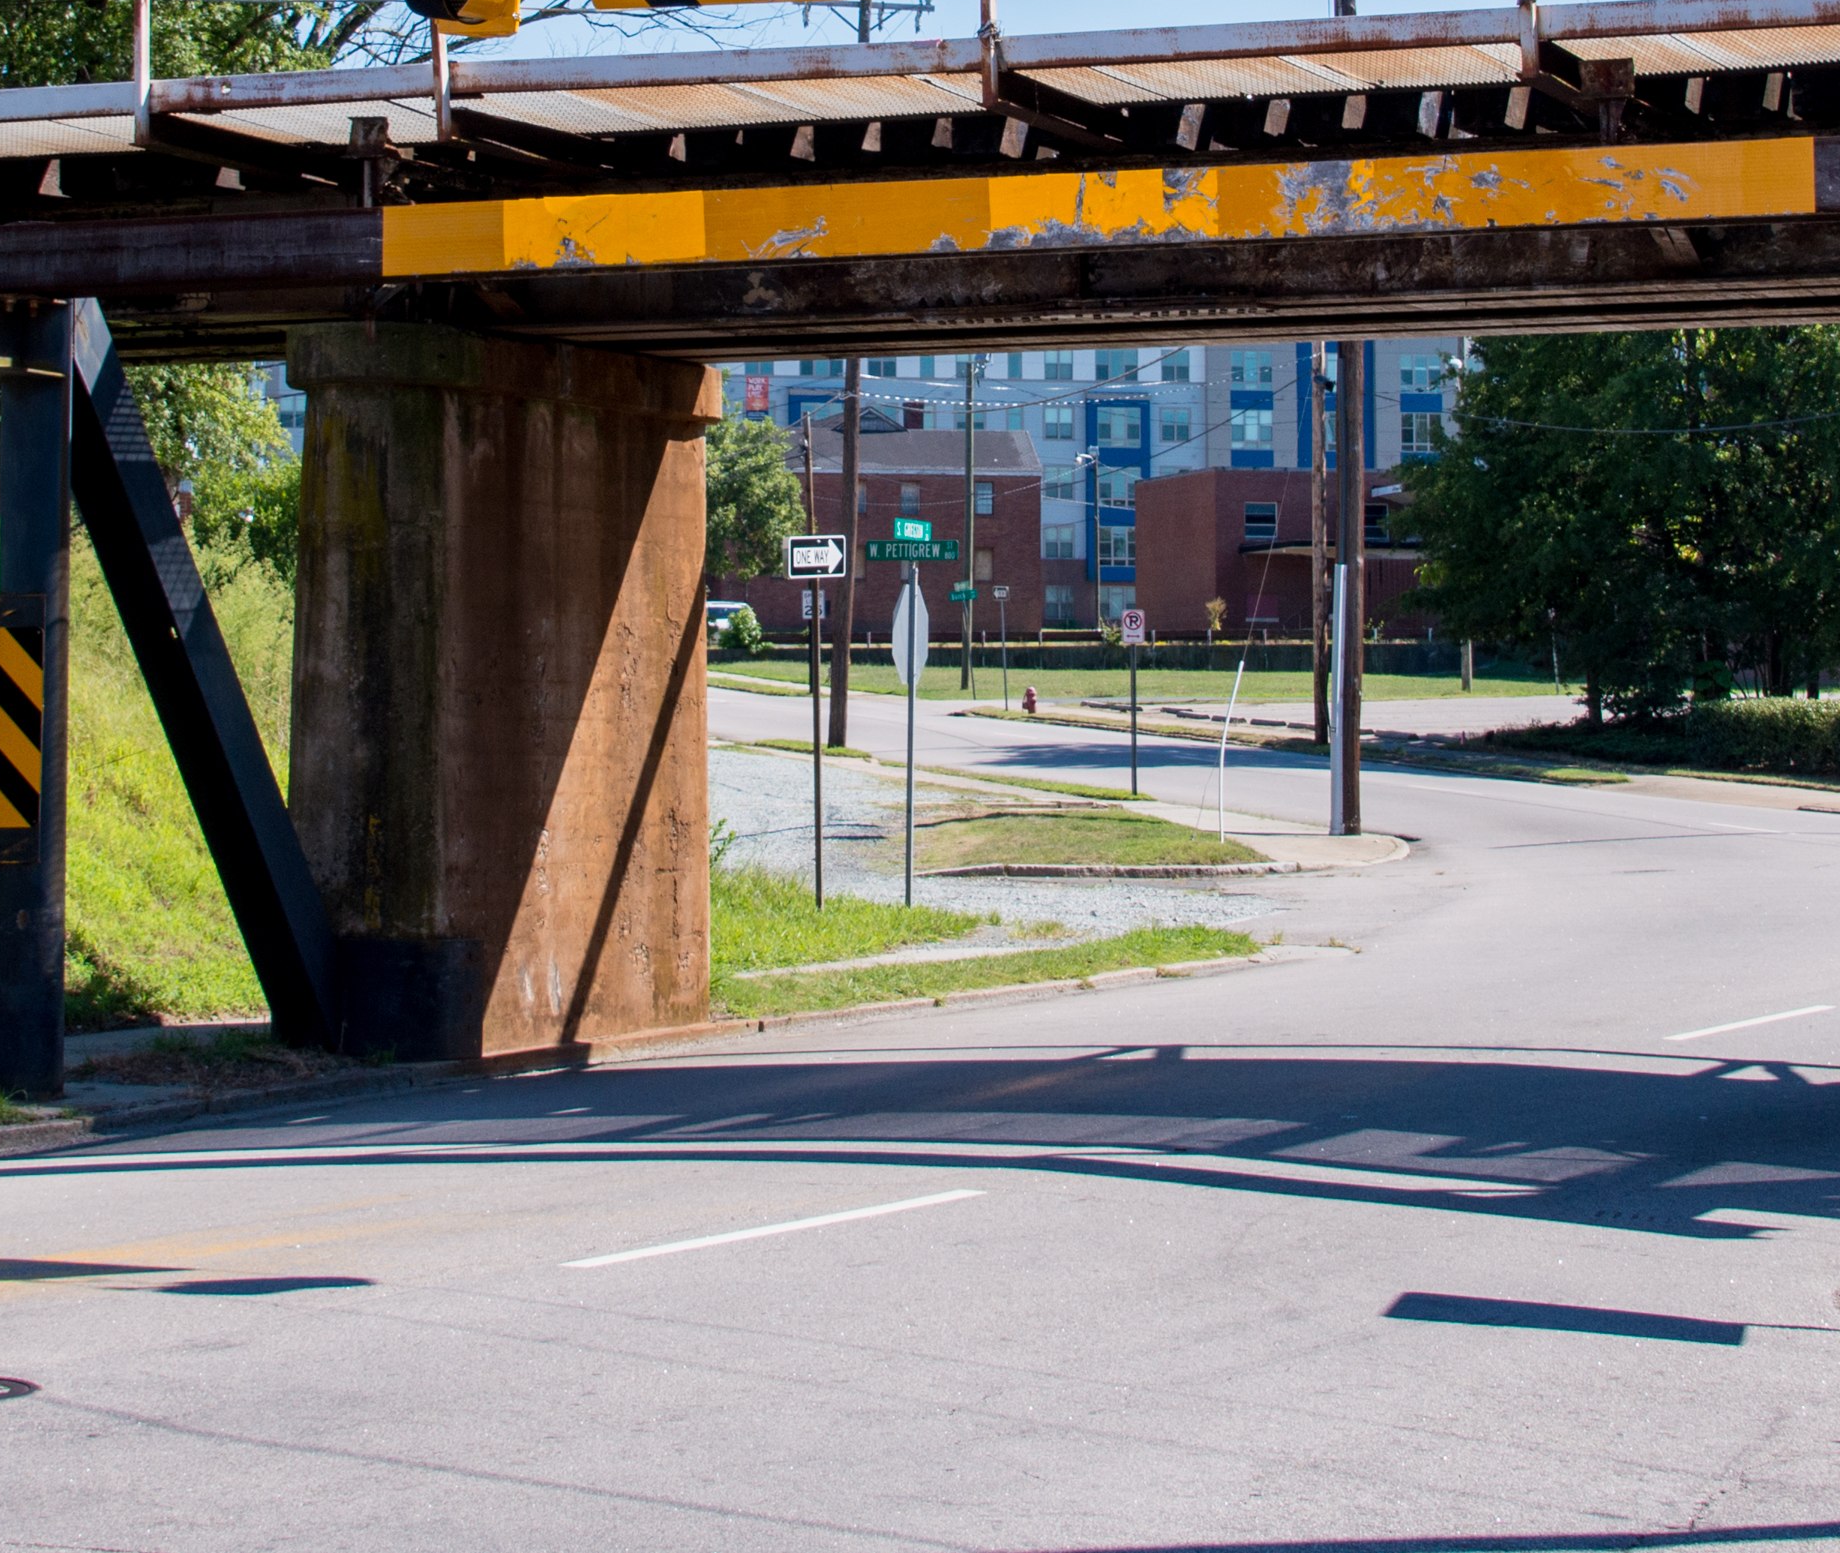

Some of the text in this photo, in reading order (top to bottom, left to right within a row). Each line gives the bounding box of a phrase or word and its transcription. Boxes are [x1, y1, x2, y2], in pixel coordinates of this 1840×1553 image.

[796, 548, 829, 564] ONE WAY
[885, 543, 941, 558] PETTIGREW
